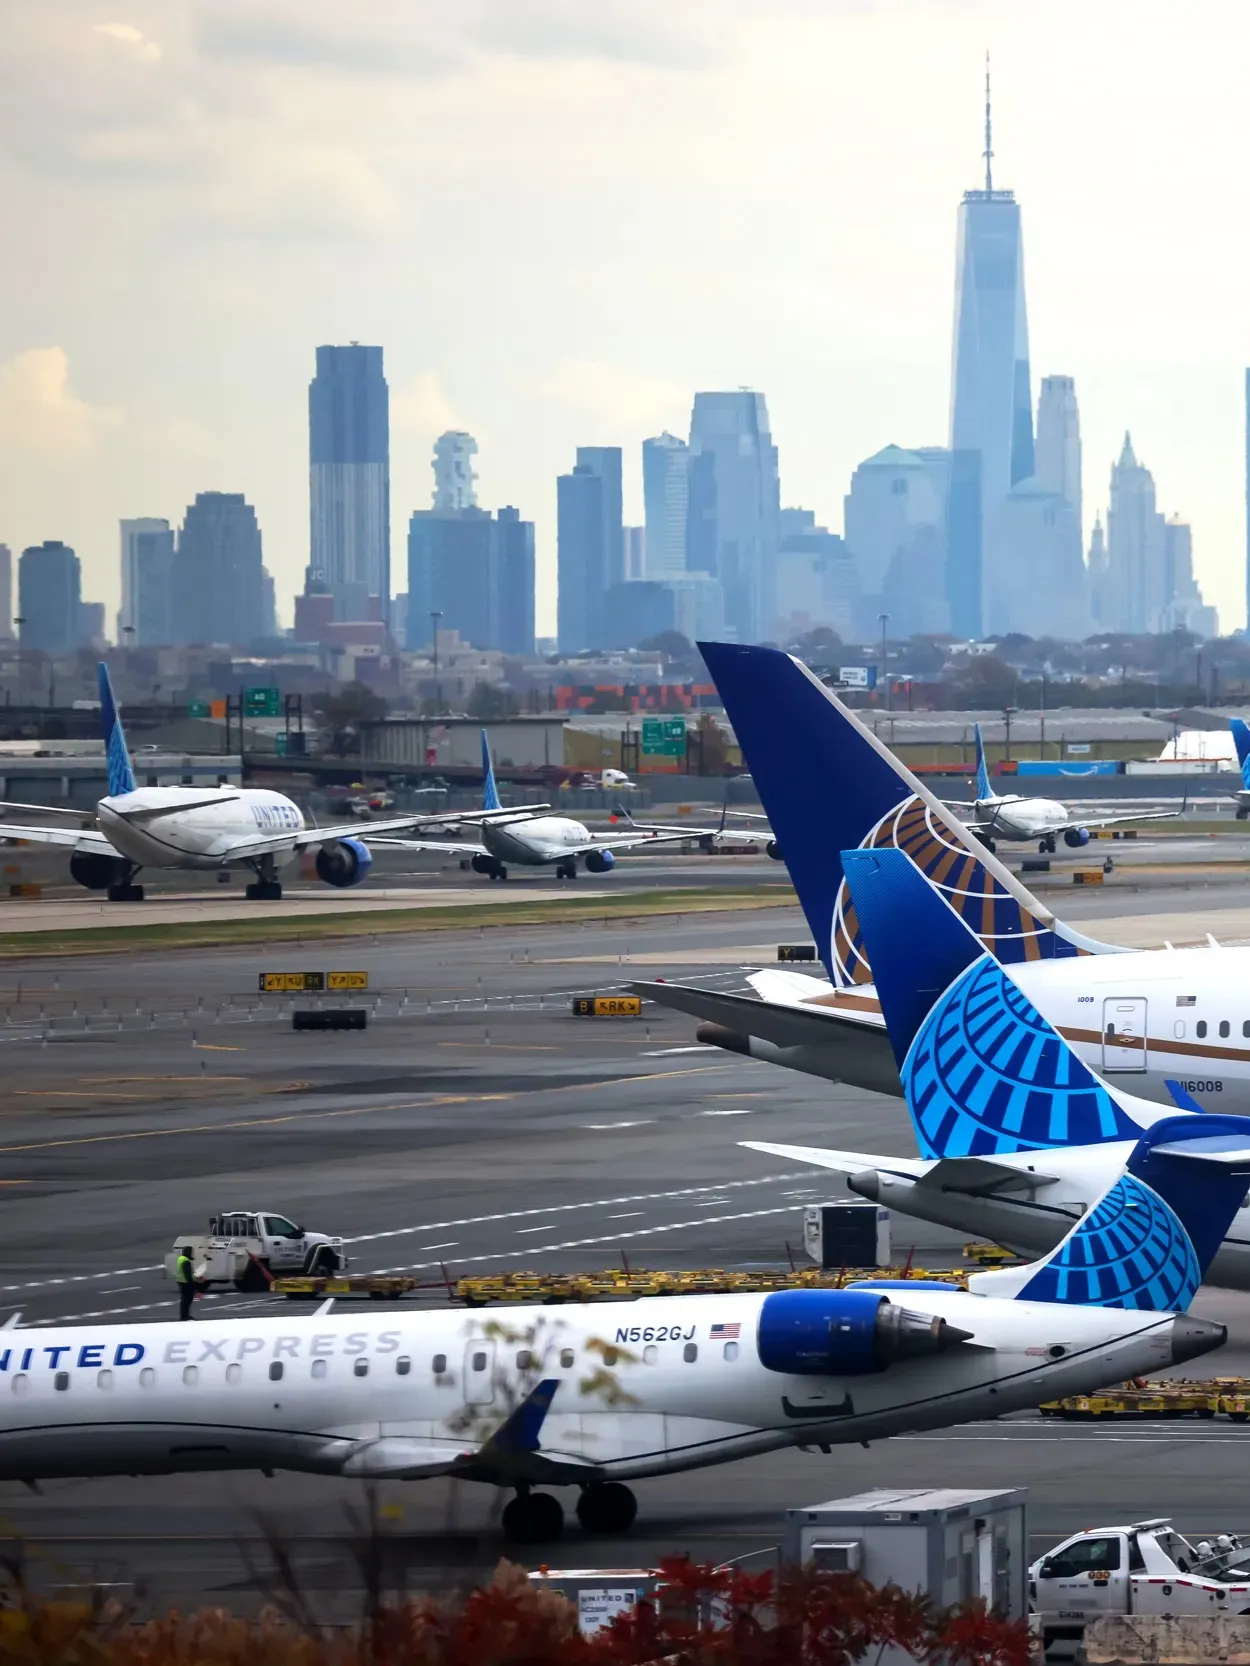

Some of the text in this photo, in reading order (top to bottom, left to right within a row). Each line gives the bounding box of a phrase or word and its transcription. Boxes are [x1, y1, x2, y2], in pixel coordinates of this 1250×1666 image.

[249, 804, 300, 829] UNITED
[580, 1000, 626, 1012] B RK
[614, 1324, 697, 1343] N562GJ
[162, 1330, 403, 1365] EXPRESS
